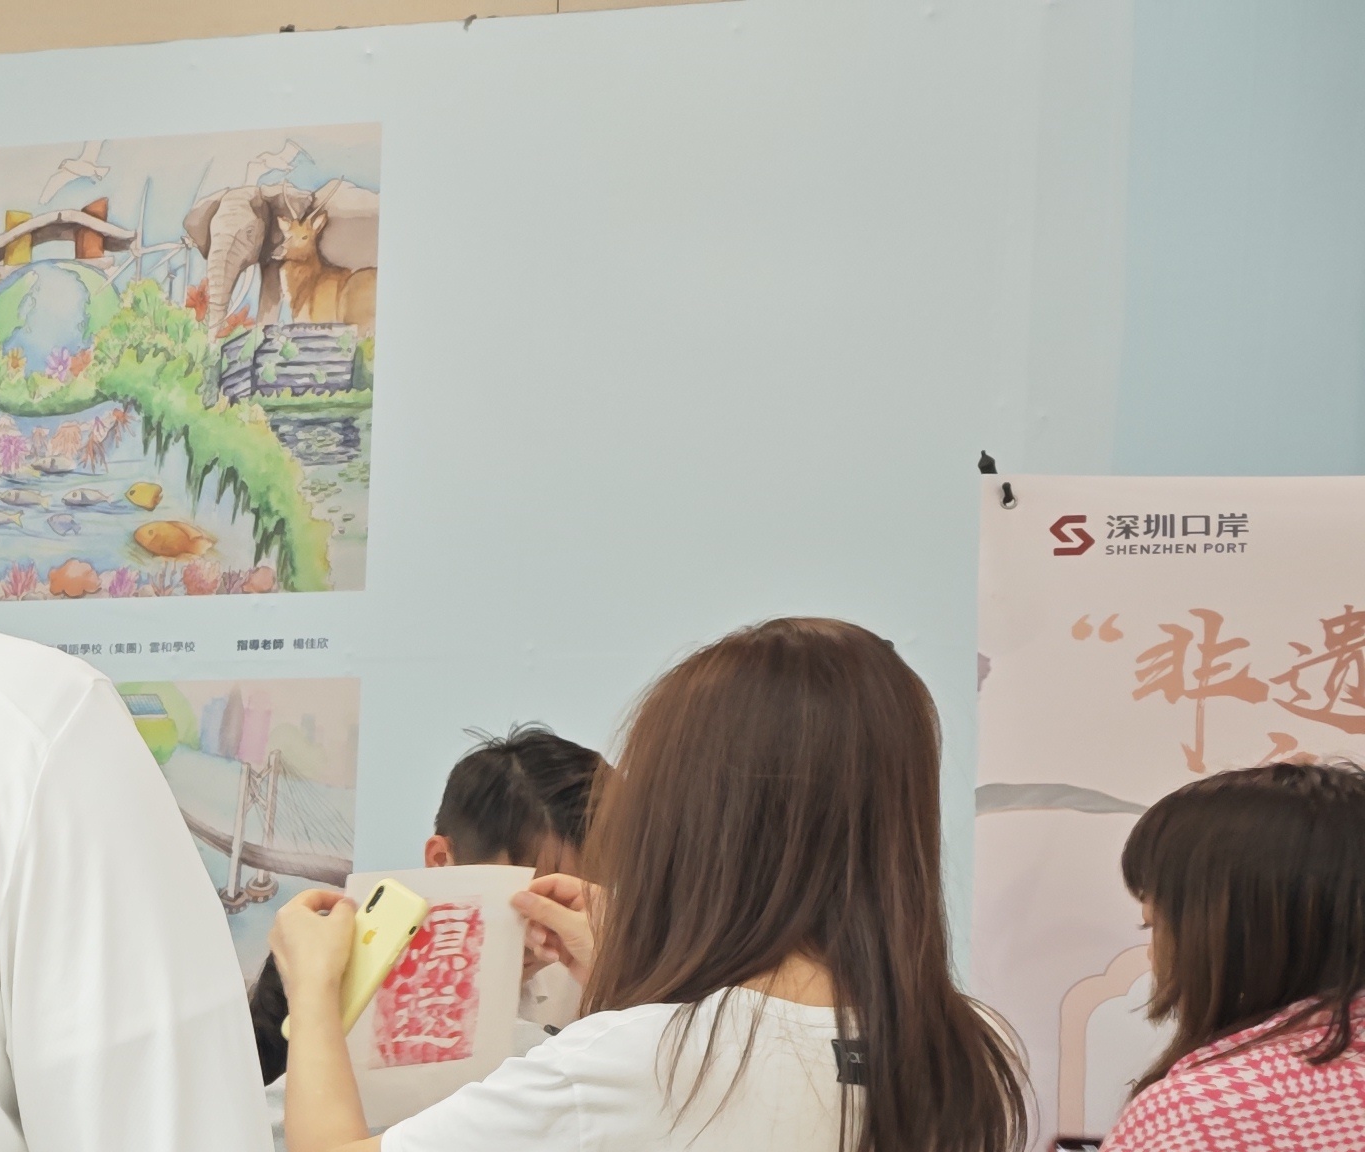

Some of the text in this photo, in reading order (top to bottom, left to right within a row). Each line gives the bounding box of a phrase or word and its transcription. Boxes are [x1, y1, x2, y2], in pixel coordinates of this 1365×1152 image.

[1106, 513, 1249, 539] 深圳口岸
[1105, 543, 1248, 555] SHENZHEN PORT
